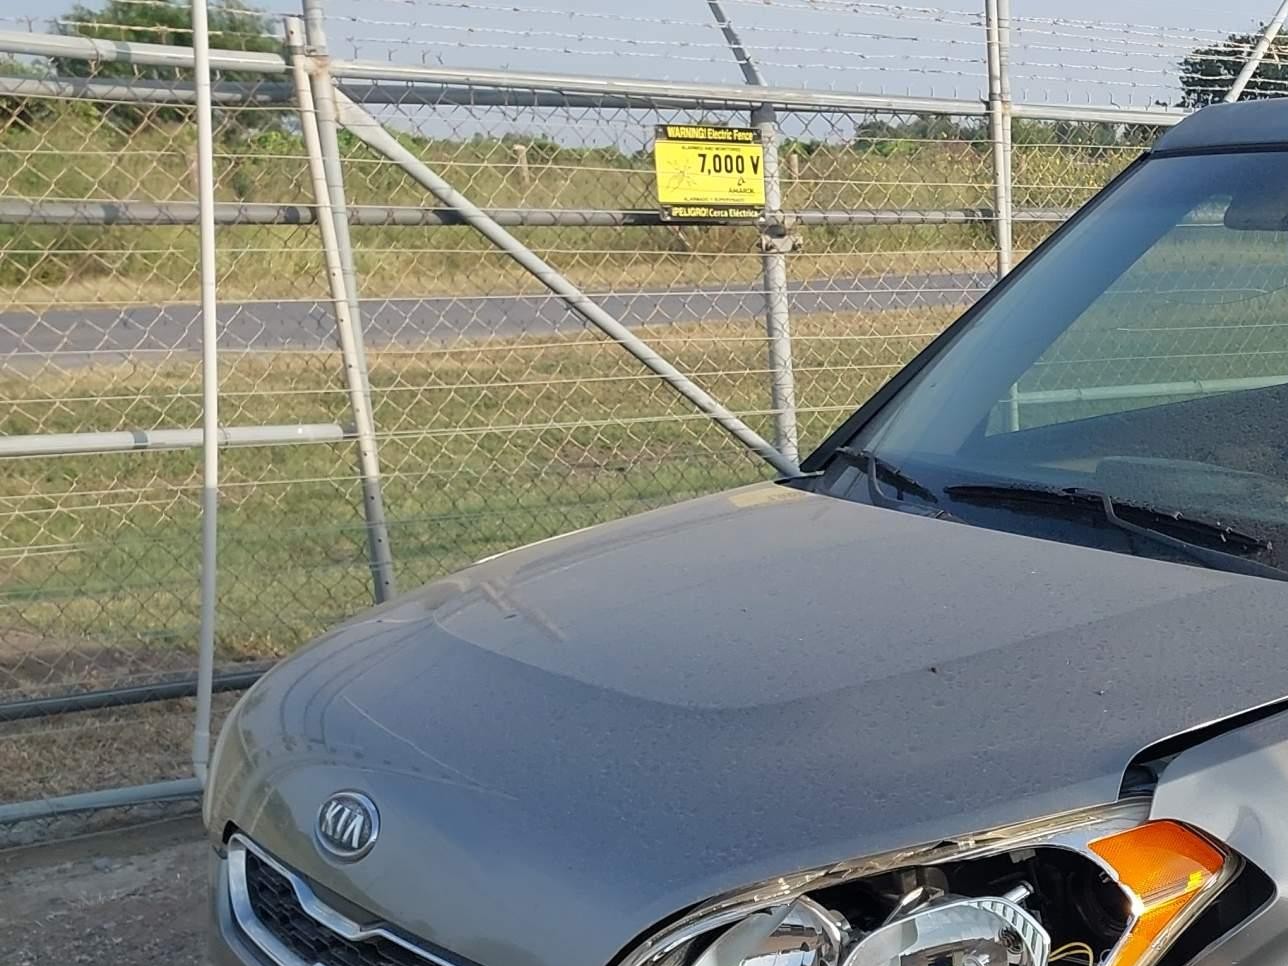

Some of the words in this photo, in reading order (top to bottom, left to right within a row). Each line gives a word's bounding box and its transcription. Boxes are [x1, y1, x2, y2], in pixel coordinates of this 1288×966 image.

[667, 126, 706, 139] WARNING!
[707, 129, 732, 140] Electric
[733, 131, 753, 141] Fence
[698, 154, 745, 175] 7,000
[750, 155, 760, 175] V
[709, 209, 728, 217] Cerca
[321, 801, 364, 849] KIA
